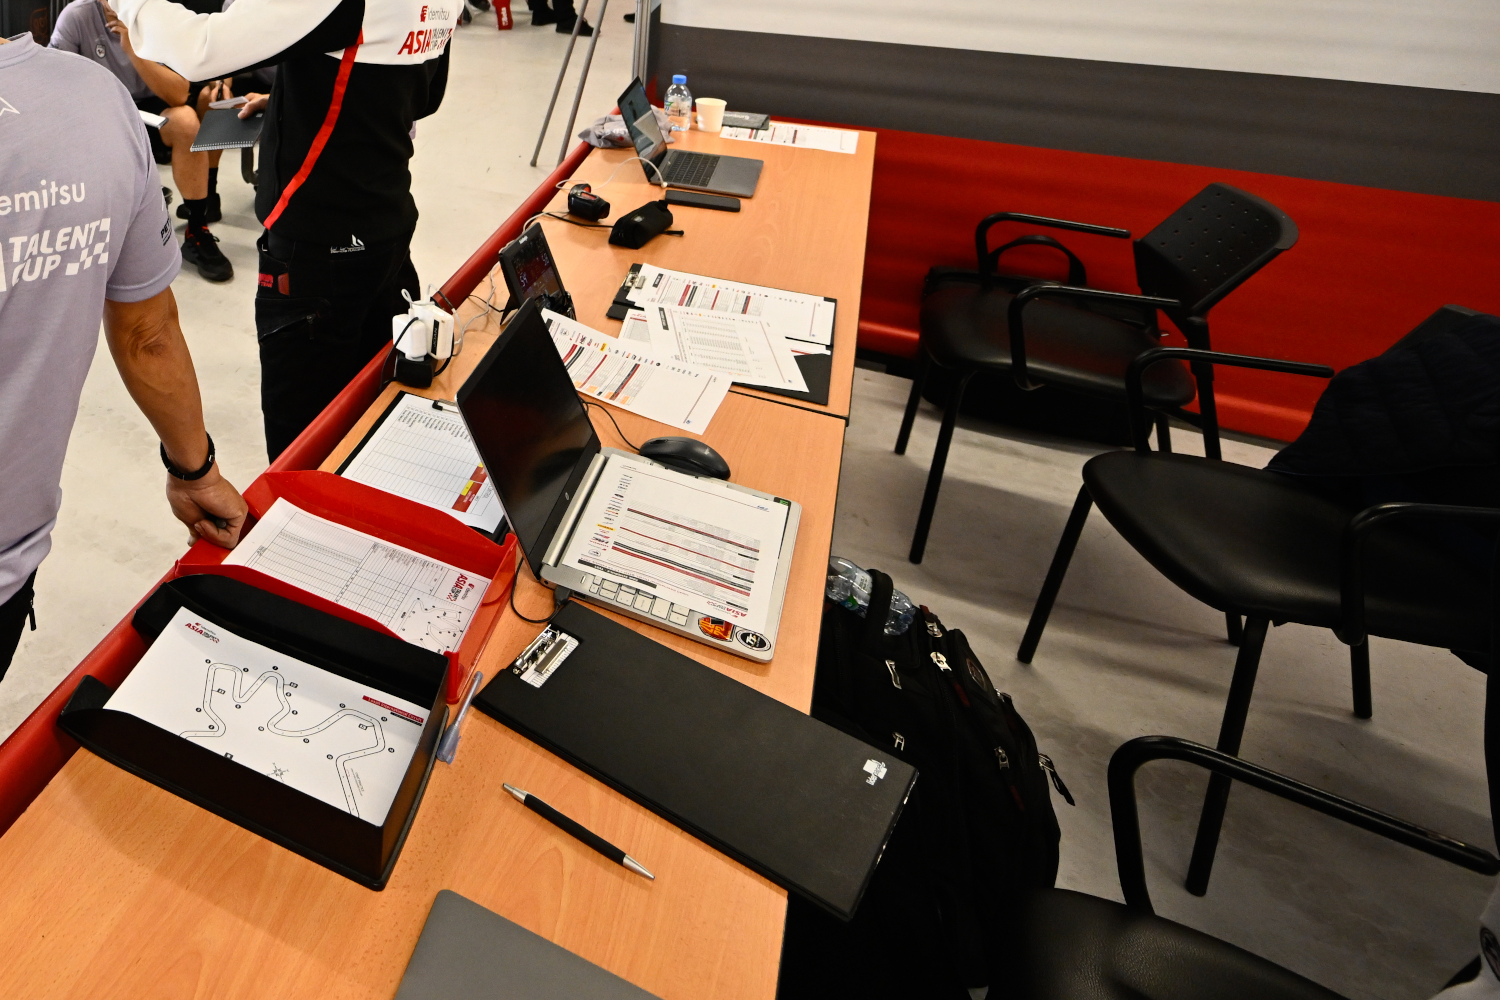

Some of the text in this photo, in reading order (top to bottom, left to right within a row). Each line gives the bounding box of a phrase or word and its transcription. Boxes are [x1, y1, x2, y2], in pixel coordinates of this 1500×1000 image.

[428, 8, 450, 21] idemitsu
[397, 29, 432, 55] ASIA
[9, 219, 101, 262] TALENT
[12, 254, 61, 287] CUP
[454, 573, 468, 589] ASIA
[185, 622, 203, 635] ASIA
